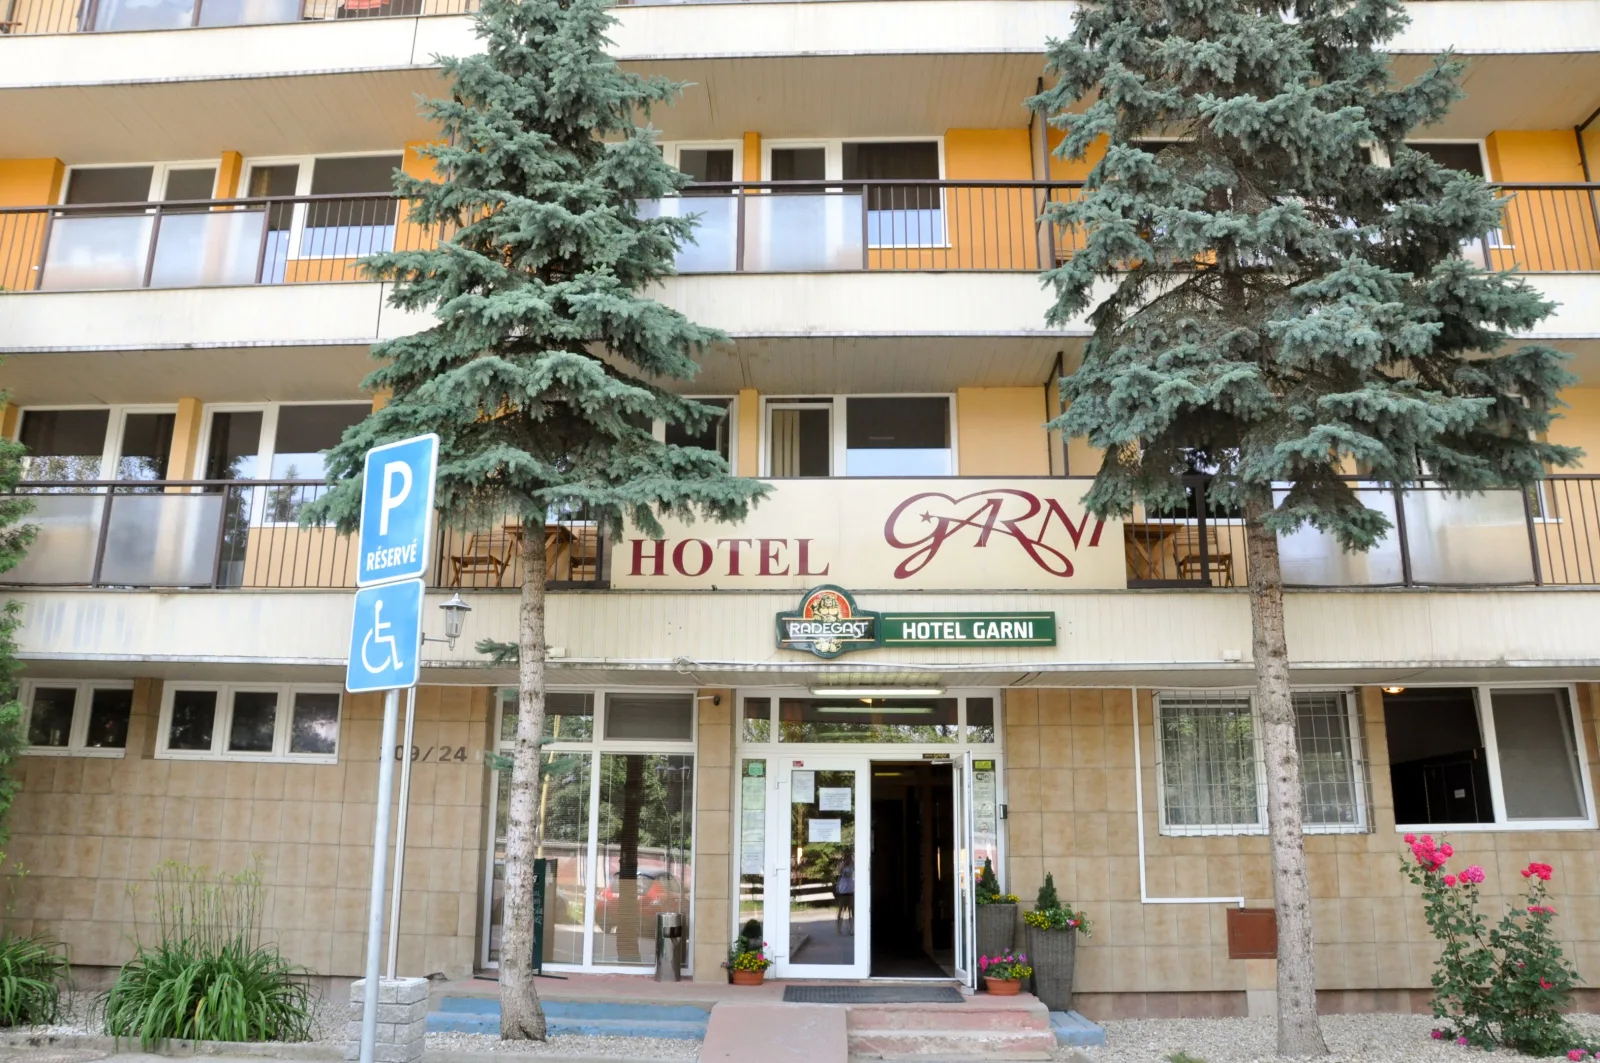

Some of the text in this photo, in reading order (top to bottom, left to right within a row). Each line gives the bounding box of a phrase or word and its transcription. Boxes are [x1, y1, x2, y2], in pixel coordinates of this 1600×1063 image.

[379, 461, 412, 536] P
[626, 489, 1106, 579] HOTEL GARNI
[366, 539, 417, 571] RÉSERVÉ
[789, 621, 868, 639] RADEGAST
[903, 621, 1033, 639] HOTEL GARNI
[379, 745, 467, 762] 09/24
